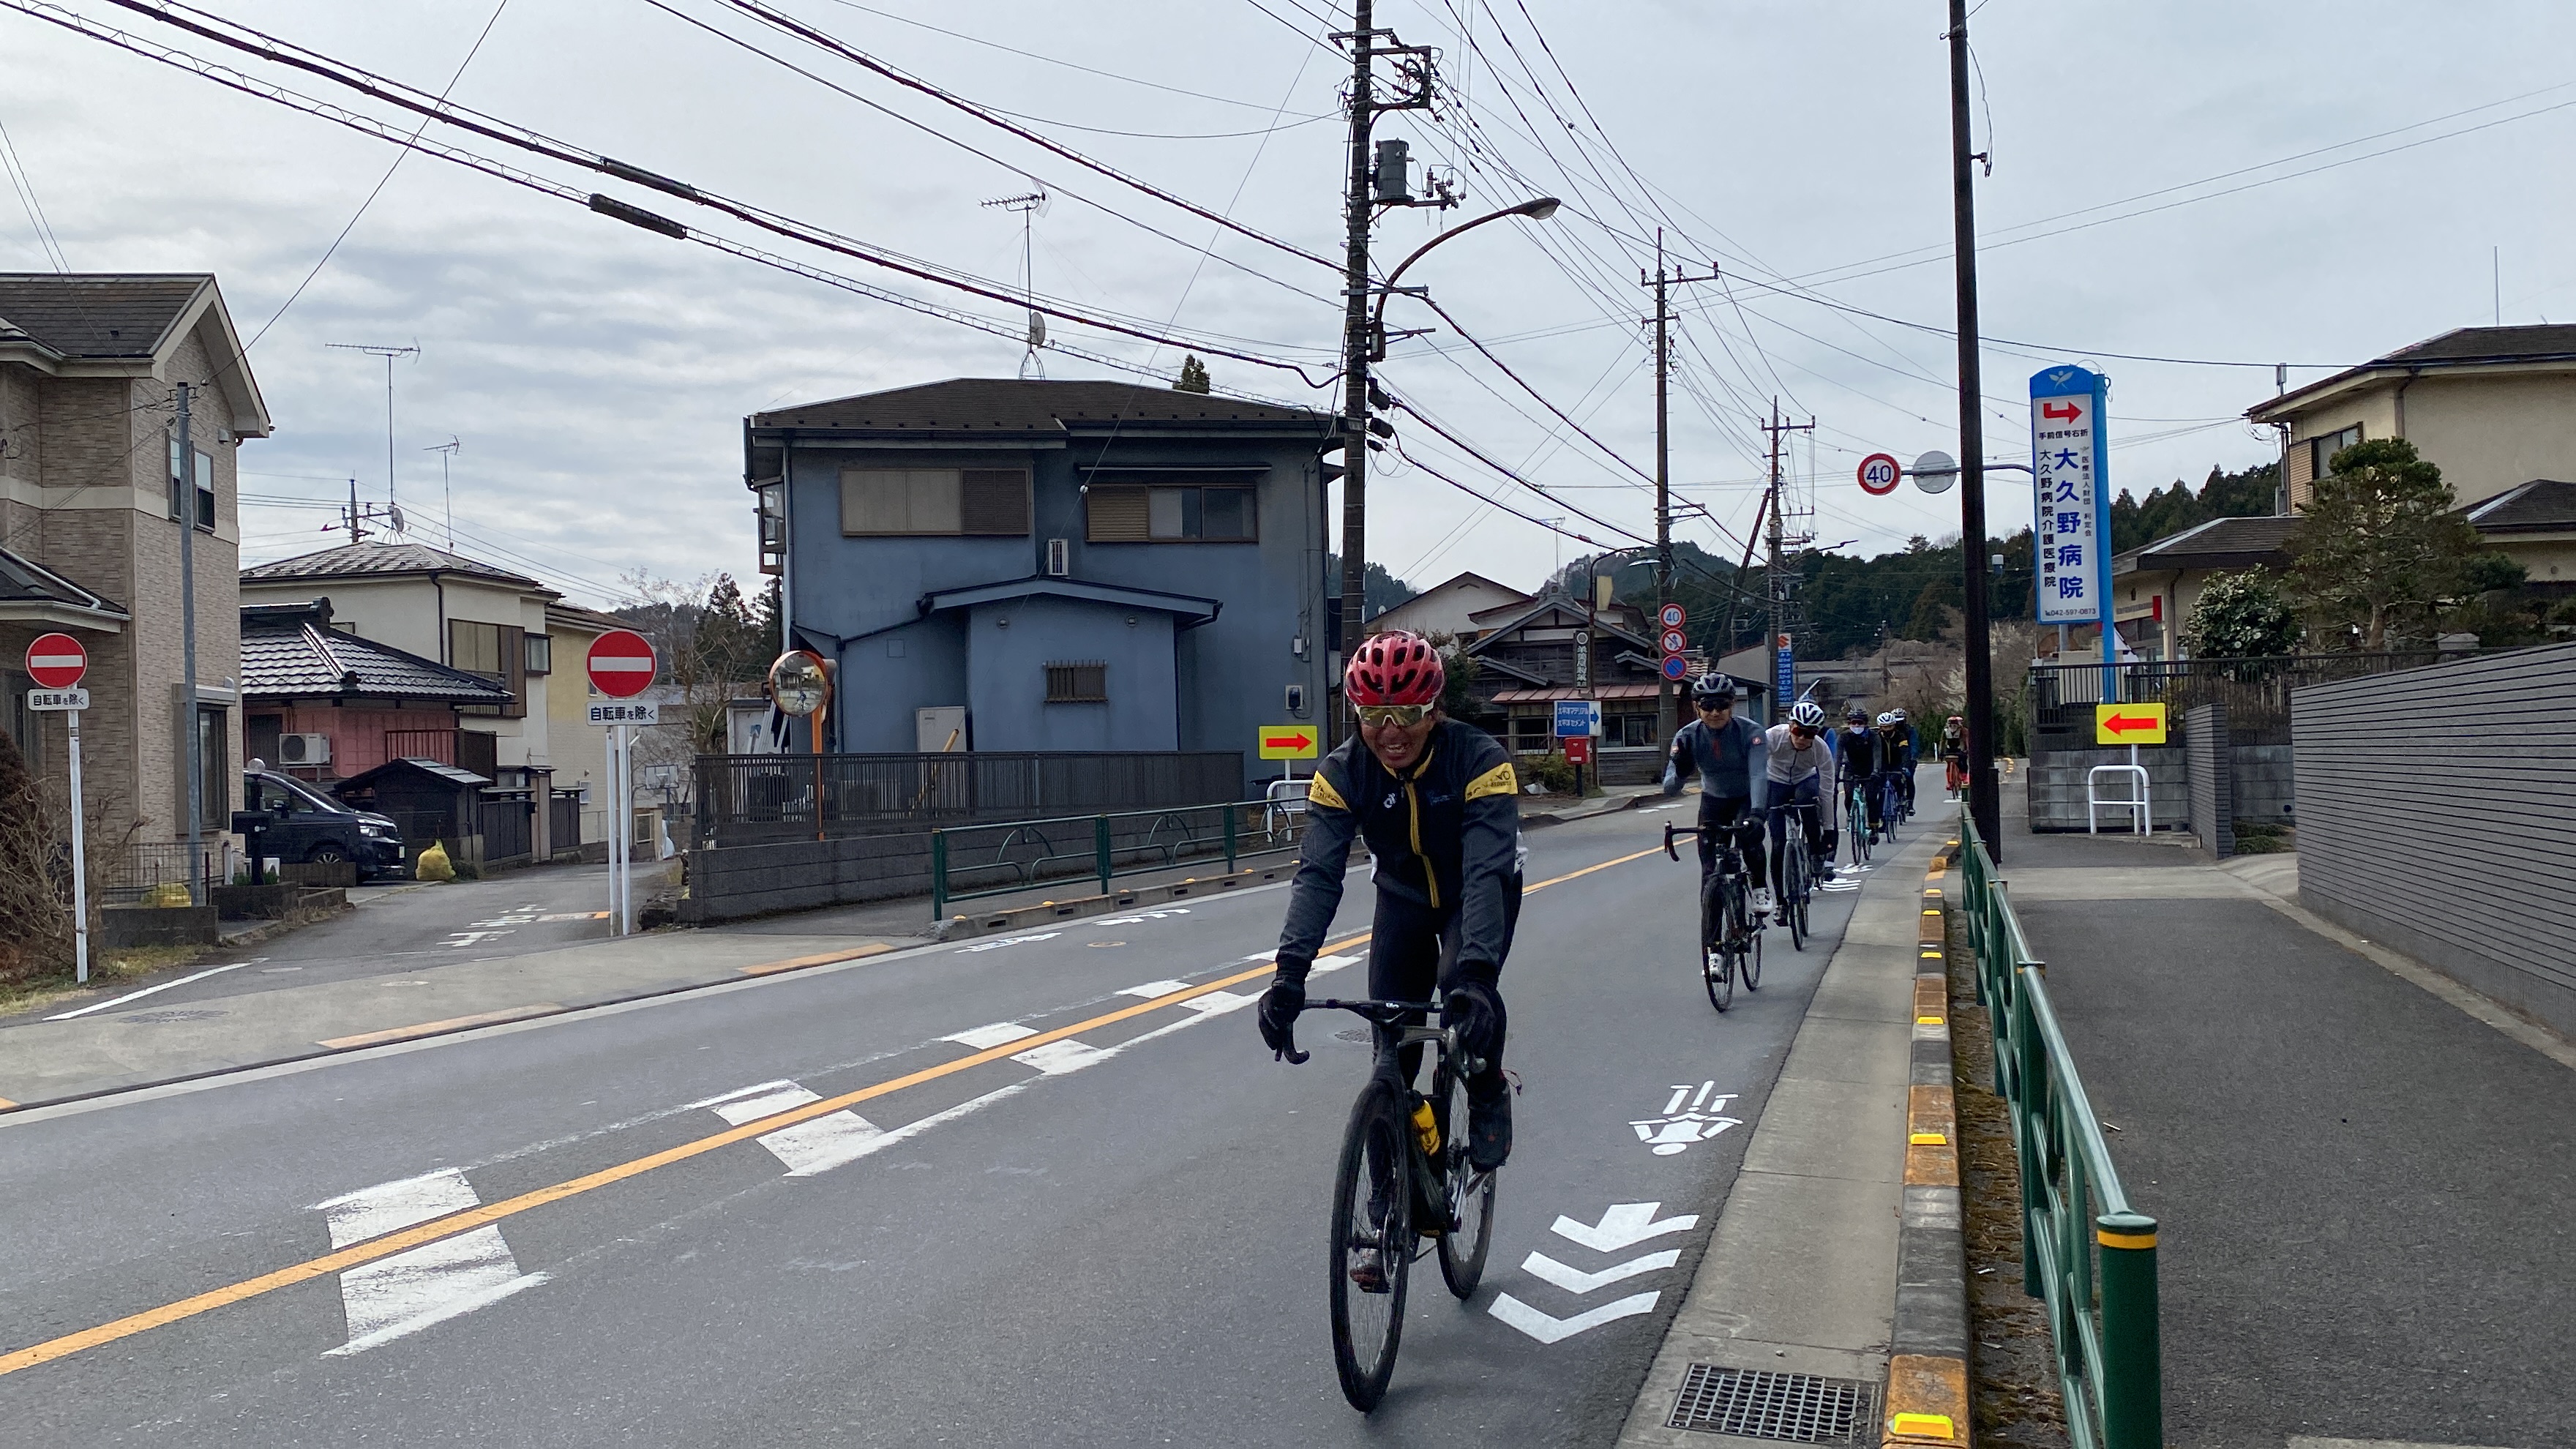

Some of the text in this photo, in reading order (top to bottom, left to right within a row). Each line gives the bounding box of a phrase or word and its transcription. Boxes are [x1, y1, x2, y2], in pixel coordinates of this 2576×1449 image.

[2039, 429, 2088, 440] 手前信号右折
[1866, 465, 1891, 483] 40
[2081, 456, 2091, 505] 医療法人財団
[2039, 449, 2057, 588] 大久野病院介護医療院
[2054, 447, 2083, 599] 大久野病院
[1666, 612, 1680, 622] 40
[34, 694, 83, 706] 自転車を除く
[591, 705, 655, 721] 自転車を除く
